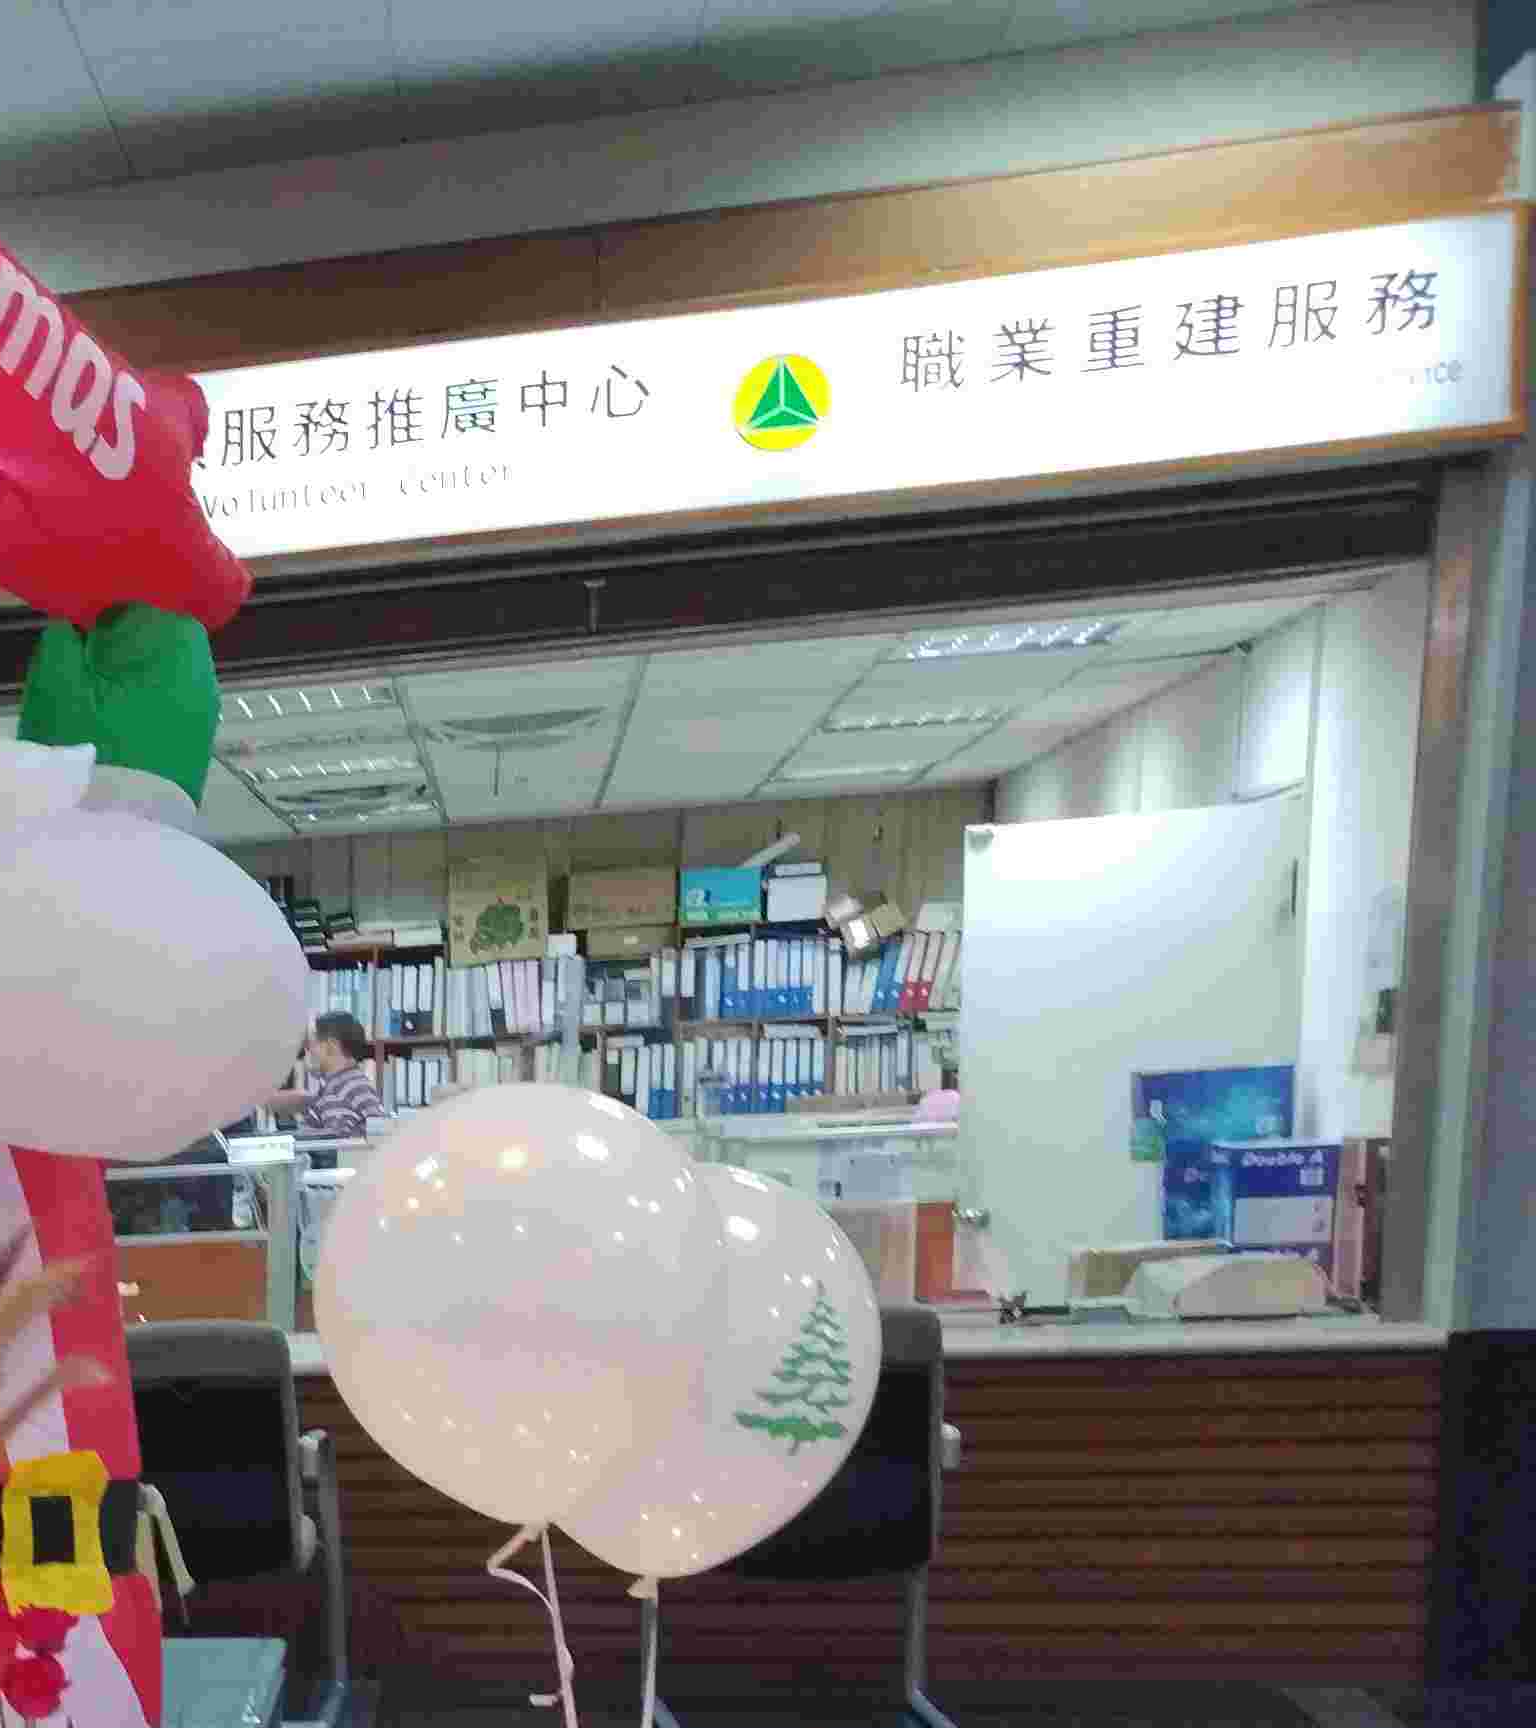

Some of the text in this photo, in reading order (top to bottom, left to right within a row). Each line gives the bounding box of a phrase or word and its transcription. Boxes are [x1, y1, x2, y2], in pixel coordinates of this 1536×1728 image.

[900, 268, 1440, 394] 職業重建服務
[195, 362, 652, 470] 服務推廣中心
